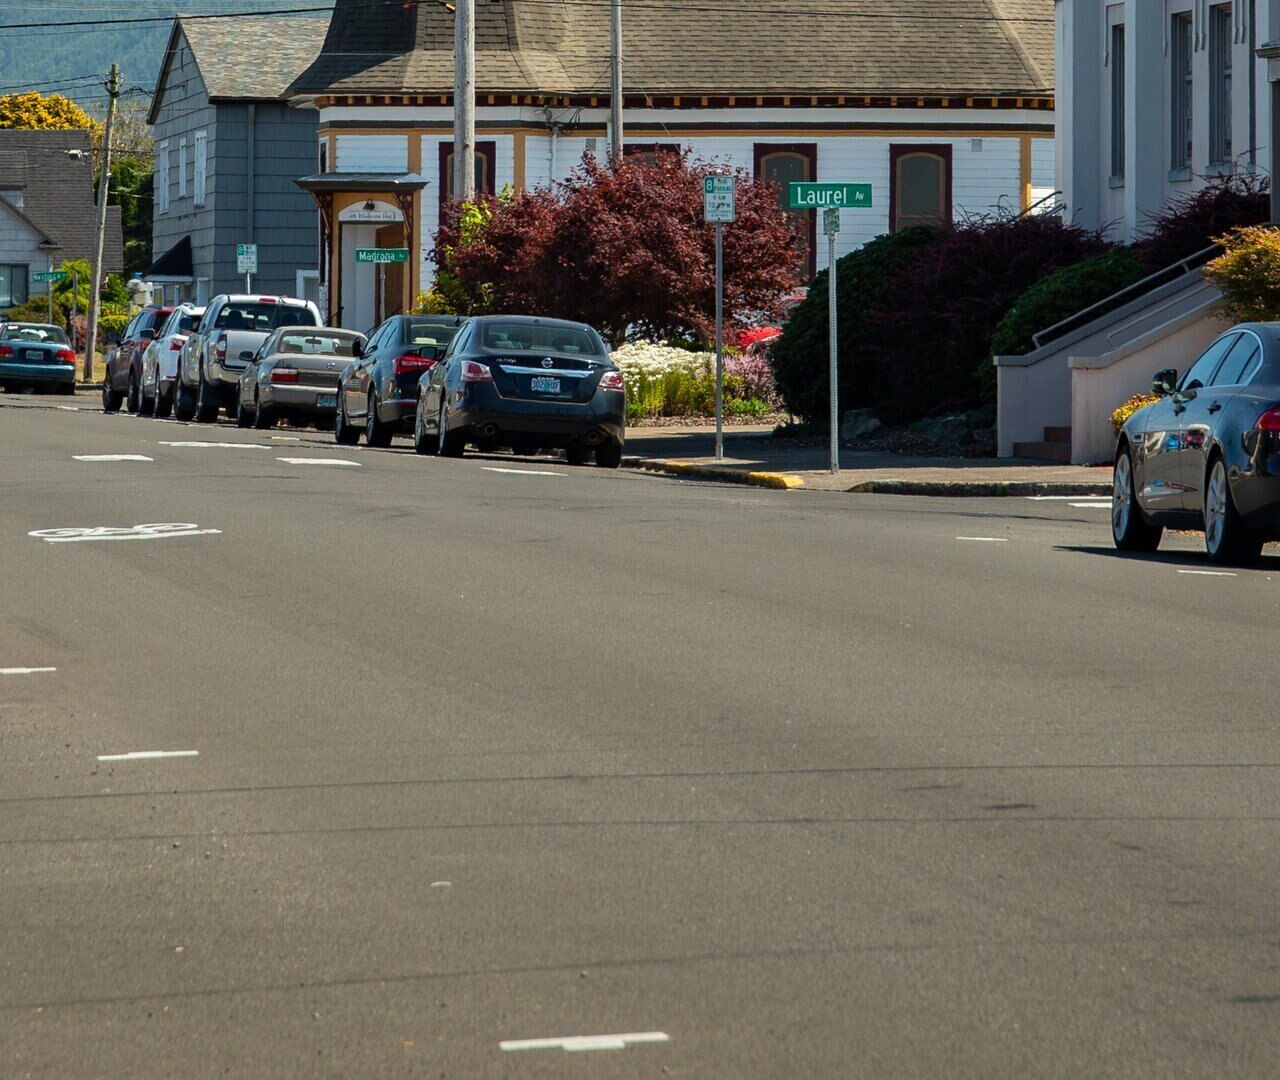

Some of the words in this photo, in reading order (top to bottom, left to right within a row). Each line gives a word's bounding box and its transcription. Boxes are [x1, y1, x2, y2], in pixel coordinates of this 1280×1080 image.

[706, 180, 713, 191] 8
[797, 186, 847, 205] Laurel
[855, 191, 865, 201] Av
[359, 251, 395, 261] Madrona
